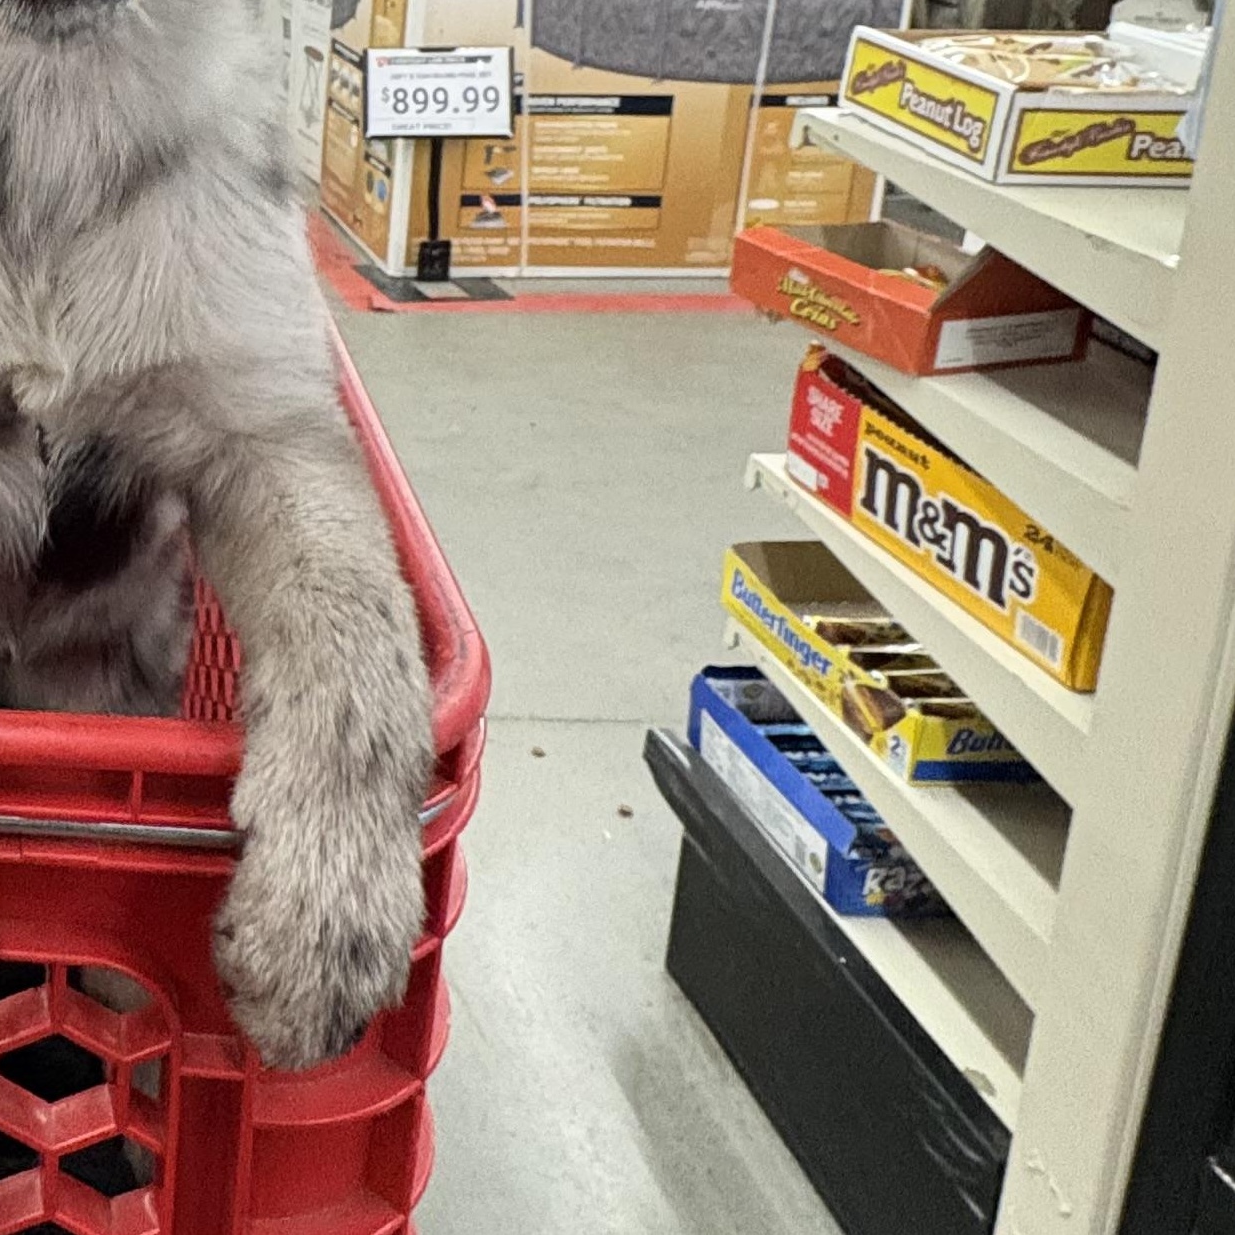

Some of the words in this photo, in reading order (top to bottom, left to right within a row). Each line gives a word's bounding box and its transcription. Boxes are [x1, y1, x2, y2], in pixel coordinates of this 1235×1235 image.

[901, 80, 955, 130] Peanut
[949, 106, 984, 150] Log
[731, 567, 833, 675] Butterfinger
